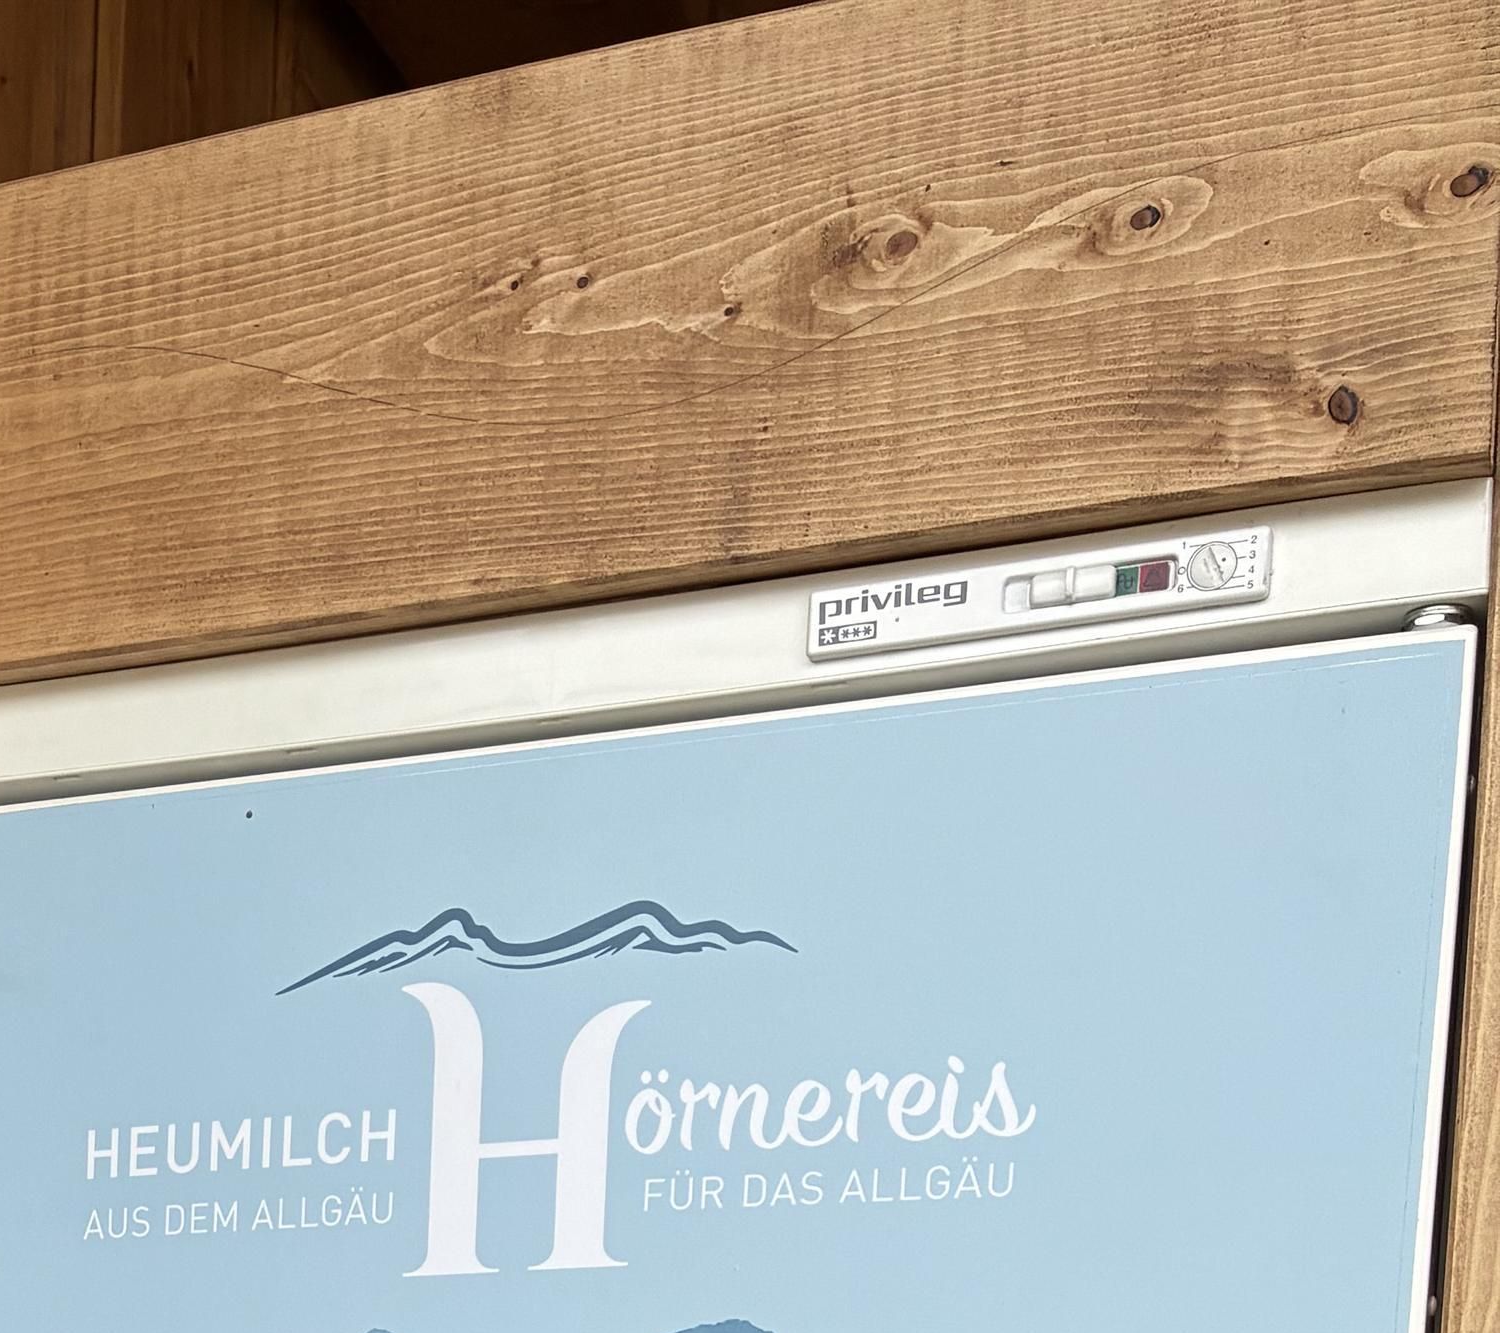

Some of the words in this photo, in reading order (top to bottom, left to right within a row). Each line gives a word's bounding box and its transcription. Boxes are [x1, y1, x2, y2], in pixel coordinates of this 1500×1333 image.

[819, 580, 968, 624] privileg
[86, 1108, 398, 1180] HEUMILCH
[643, 1169, 725, 1213] FÜR
[741, 1170, 825, 1208] DAS
[837, 1161, 1017, 1206] ALLGÄU
[83, 1206, 153, 1241] AUS
[163, 1199, 240, 1237] DEM
[250, 1189, 395, 1232] ALLGÄU
